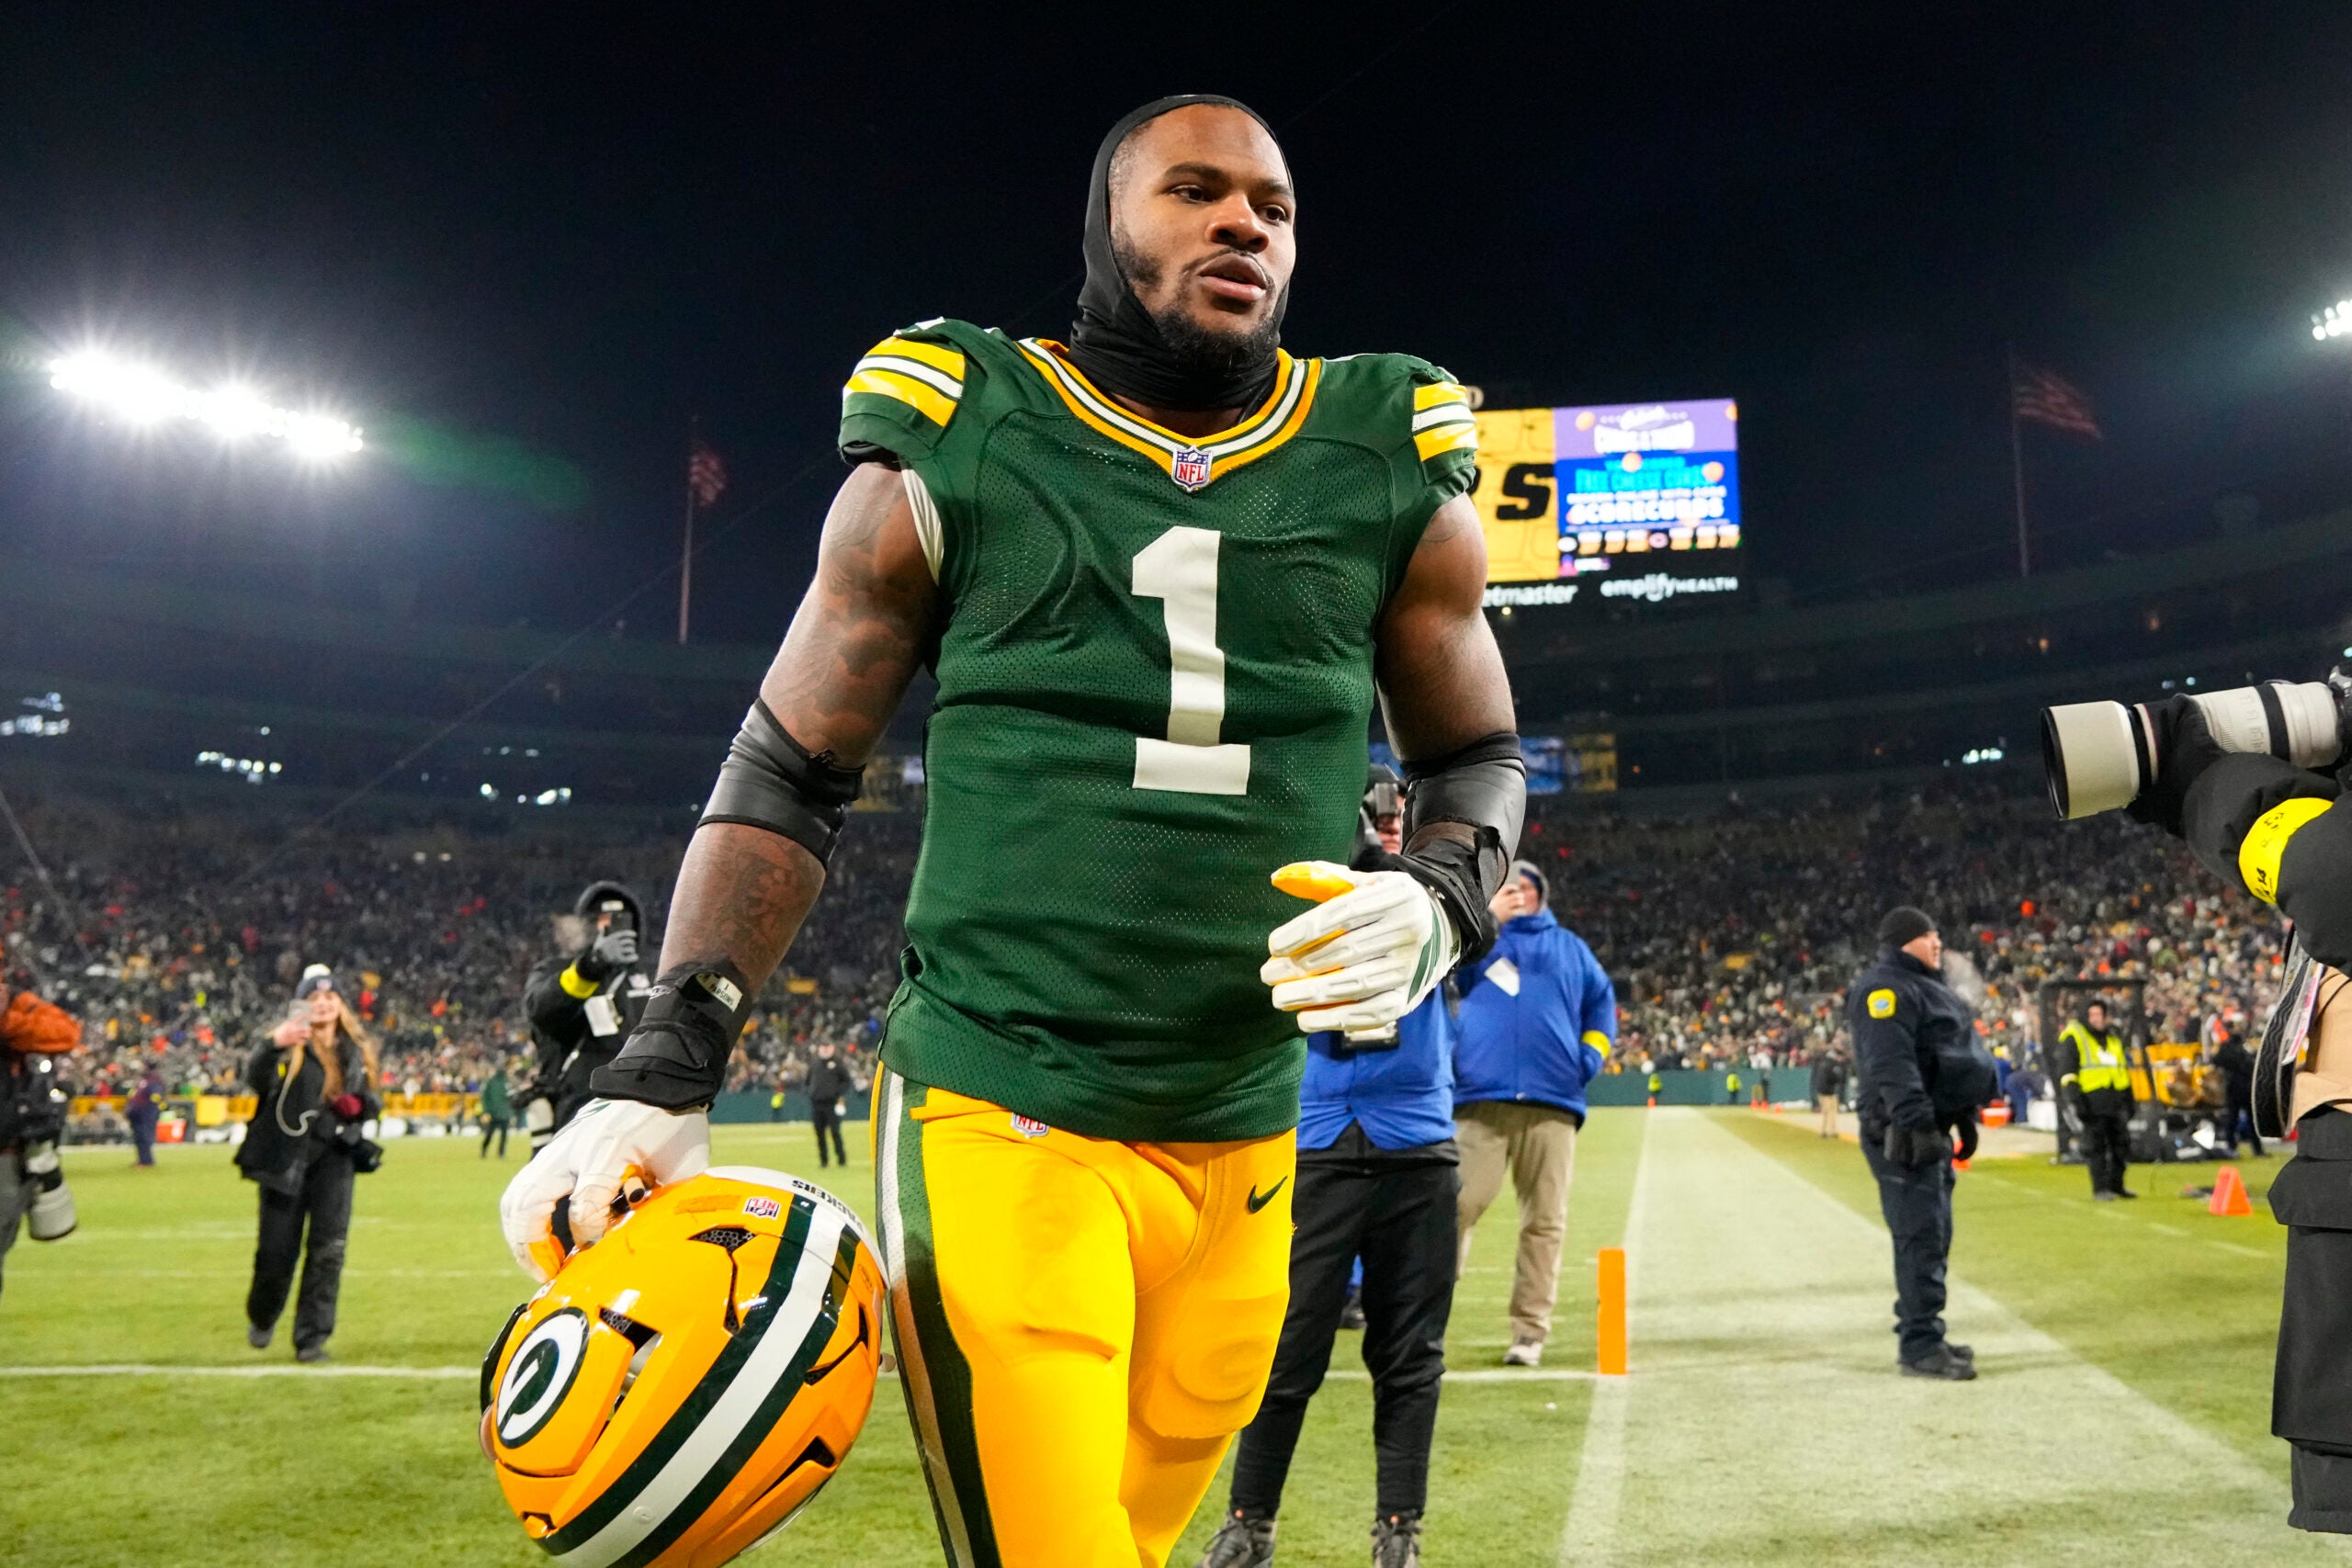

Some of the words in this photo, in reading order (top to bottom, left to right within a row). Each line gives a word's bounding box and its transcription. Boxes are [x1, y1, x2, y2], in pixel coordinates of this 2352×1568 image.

[1178, 463, 1204, 482] NFL
[1132, 525, 1250, 795] 1
[752, 1198, 776, 1211] NFL
